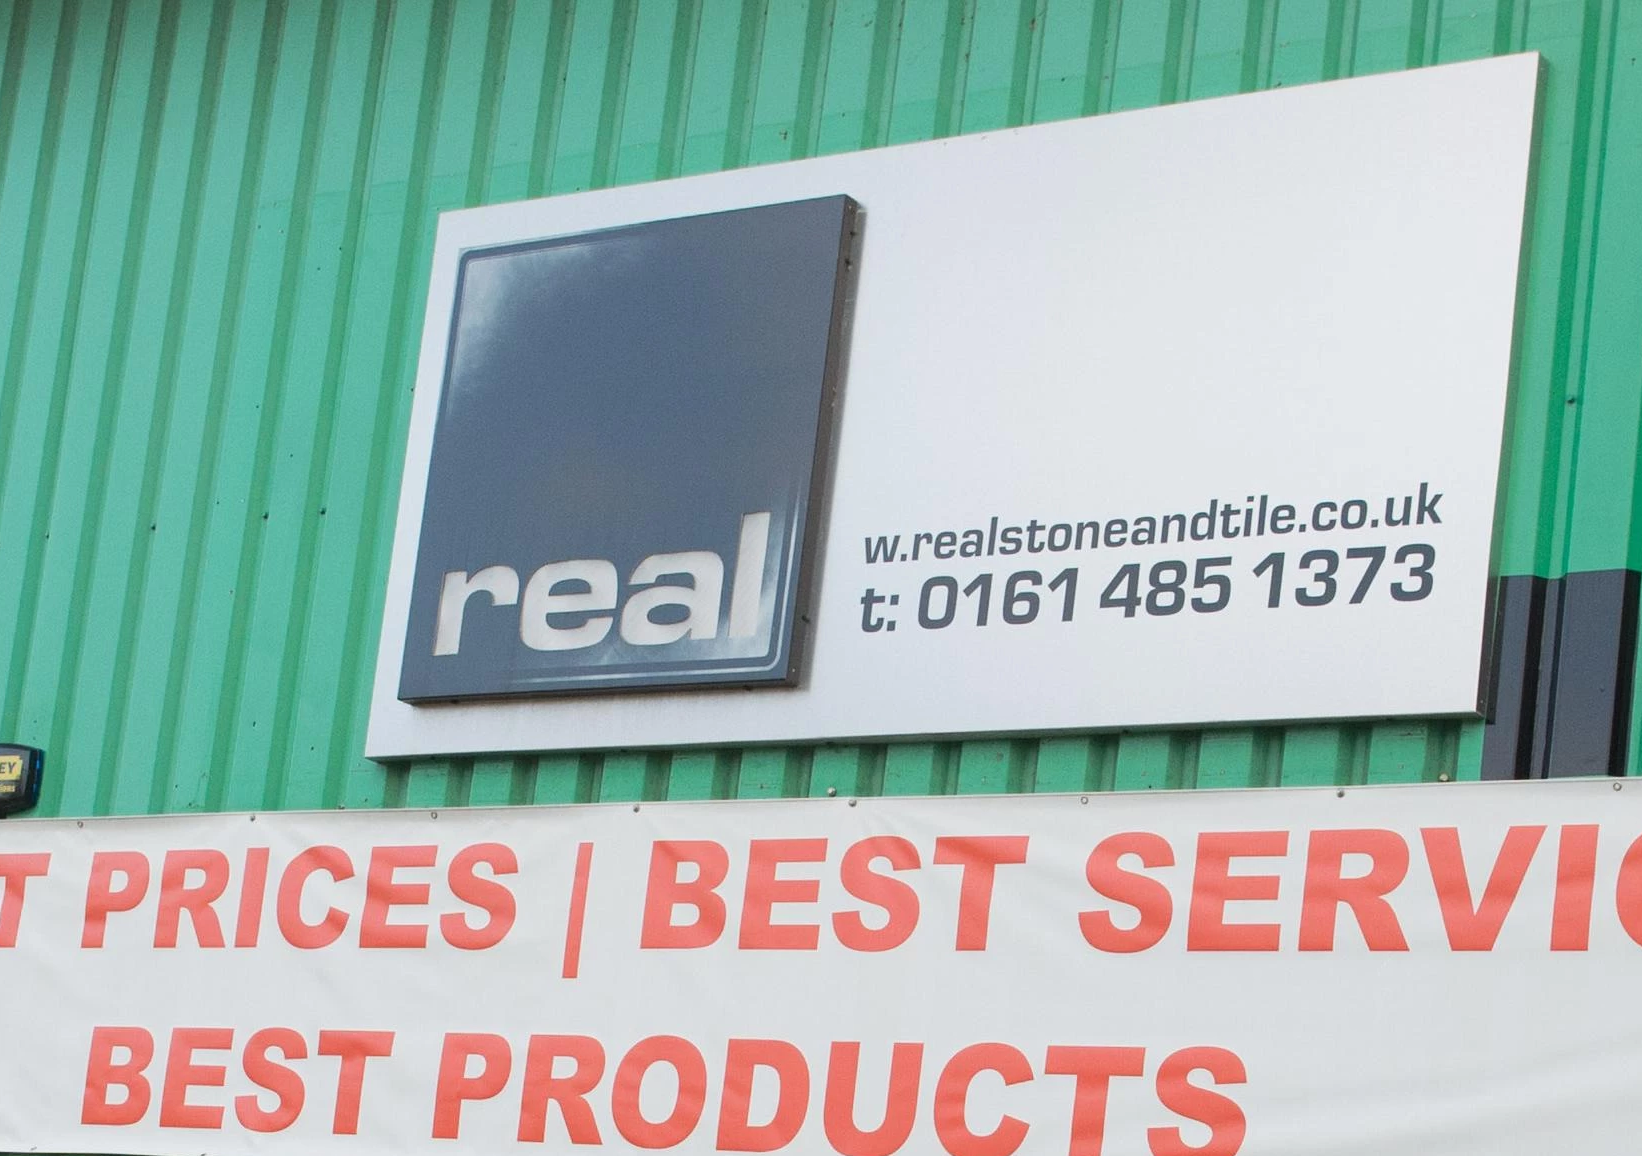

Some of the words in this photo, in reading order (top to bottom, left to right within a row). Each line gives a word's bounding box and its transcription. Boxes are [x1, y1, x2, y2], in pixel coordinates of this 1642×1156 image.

[864, 482, 1443, 564] w.realstoneandtile.co.uk
[434, 511, 771, 659] real
[860, 588, 900, 632] t:
[917, 568, 1080, 629] 0161
[1099, 556, 1233, 619] 485
[1253, 543, 1436, 608] 1373
[81, 843, 519, 950] PRICES
[641, 836, 1030, 952] BEST
[82, 1027, 395, 1135] BEST
